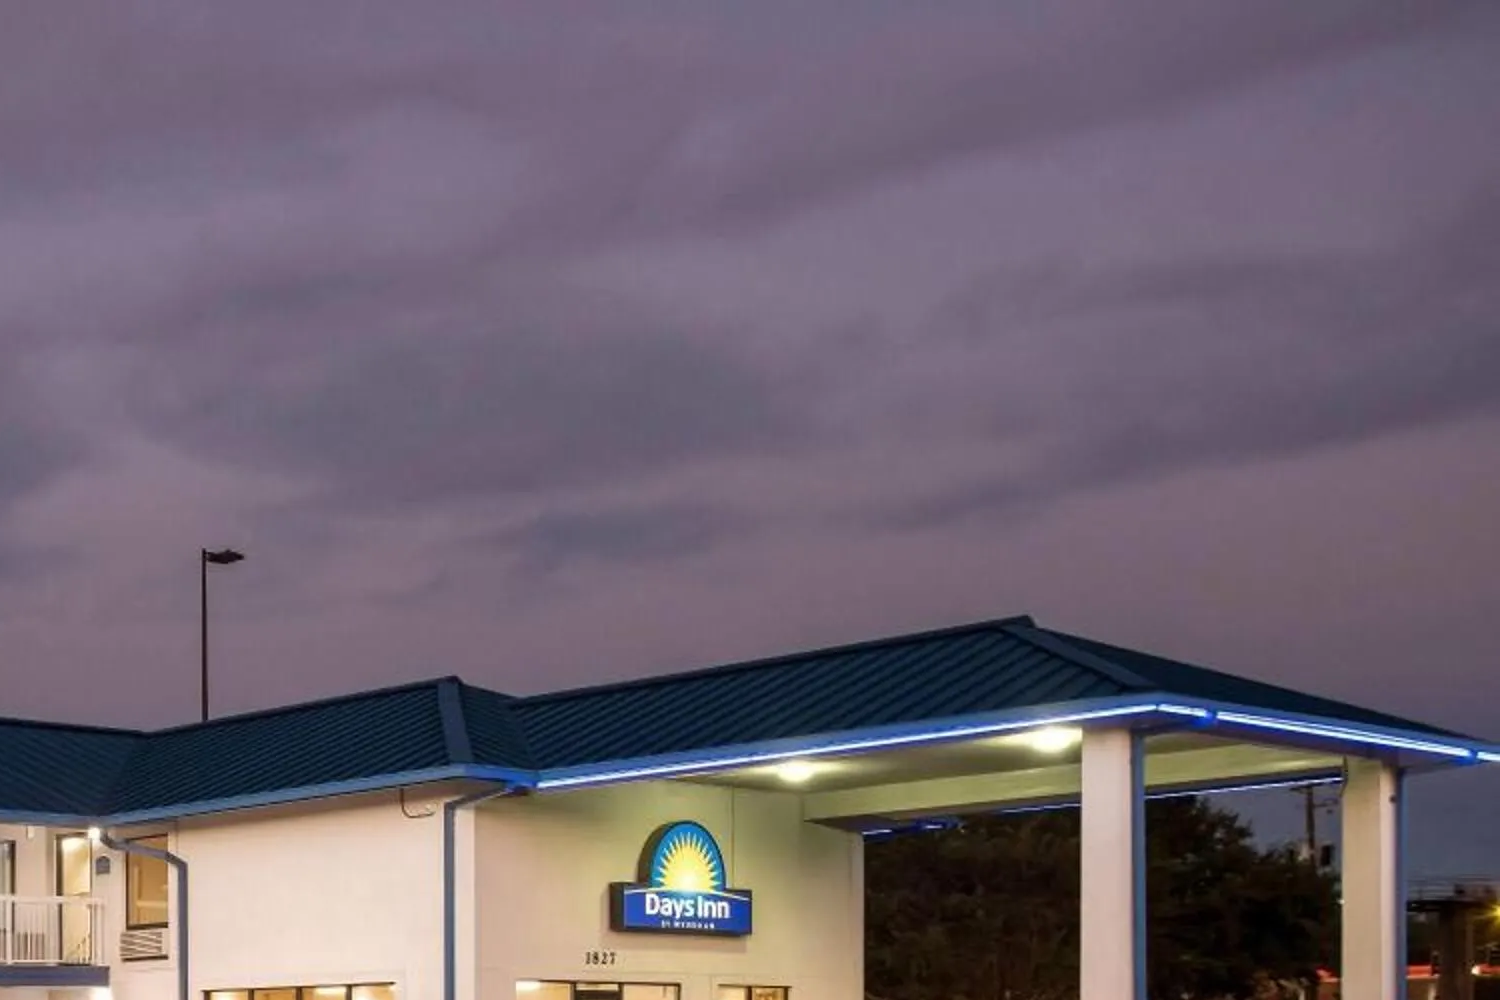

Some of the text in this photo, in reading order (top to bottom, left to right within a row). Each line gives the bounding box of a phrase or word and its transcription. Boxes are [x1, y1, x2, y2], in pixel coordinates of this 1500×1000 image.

[645, 893, 731, 919] Days Inn
[585, 951, 617, 965] 1827
